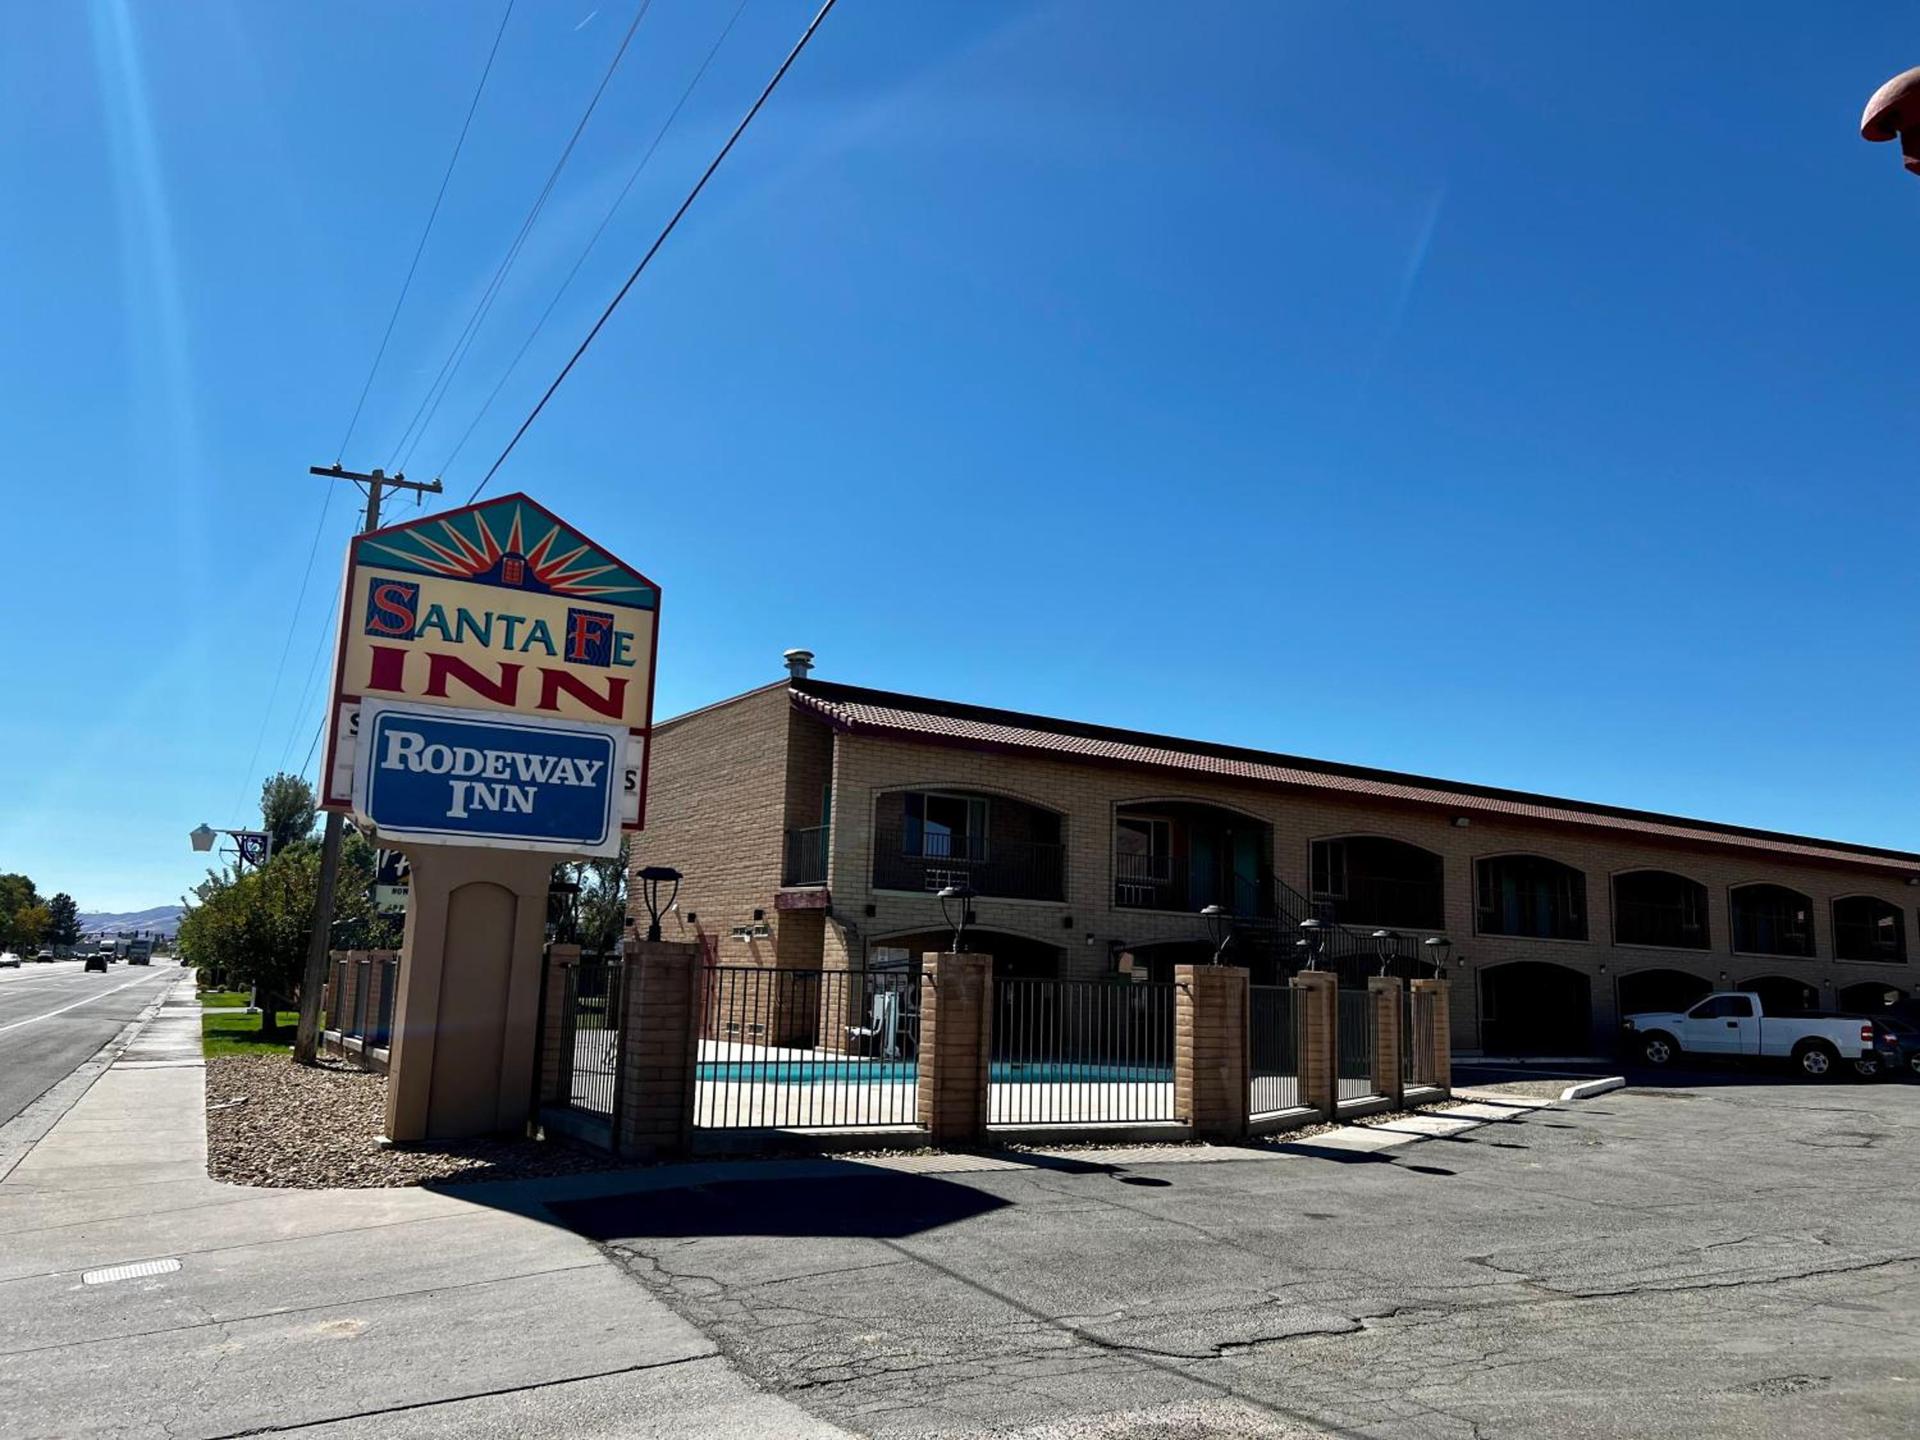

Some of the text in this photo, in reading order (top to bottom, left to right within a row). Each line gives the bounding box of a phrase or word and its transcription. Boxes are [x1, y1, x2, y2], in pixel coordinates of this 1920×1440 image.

[368, 584, 556, 656] SANTA
[367, 645, 629, 719] INN
[382, 729, 603, 787] RODEWAY
[446, 780, 538, 819] INN
